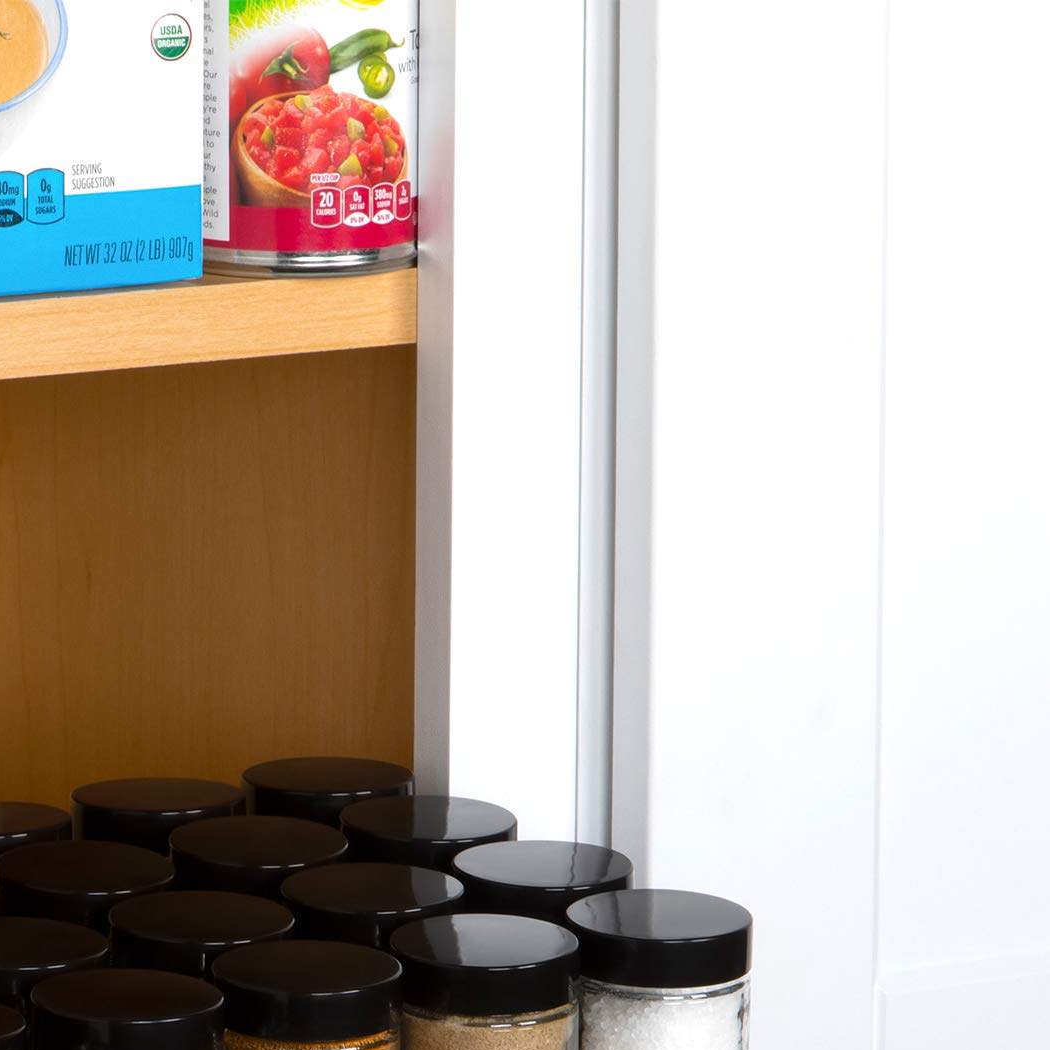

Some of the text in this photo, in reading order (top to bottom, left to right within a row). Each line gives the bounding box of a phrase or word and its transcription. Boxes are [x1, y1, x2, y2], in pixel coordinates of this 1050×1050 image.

[159, 25, 183, 36] USDA
[157, 38, 186, 48] ORGANIC
[71, 163, 102, 176] SERVING
[40, 178, 51, 193] 0g
[71, 176, 116, 190] SUGGESTION
[319, 191, 334, 208] 20
[64, 236, 194, 266] NET WT 32 OZ (2 LB) 907g
